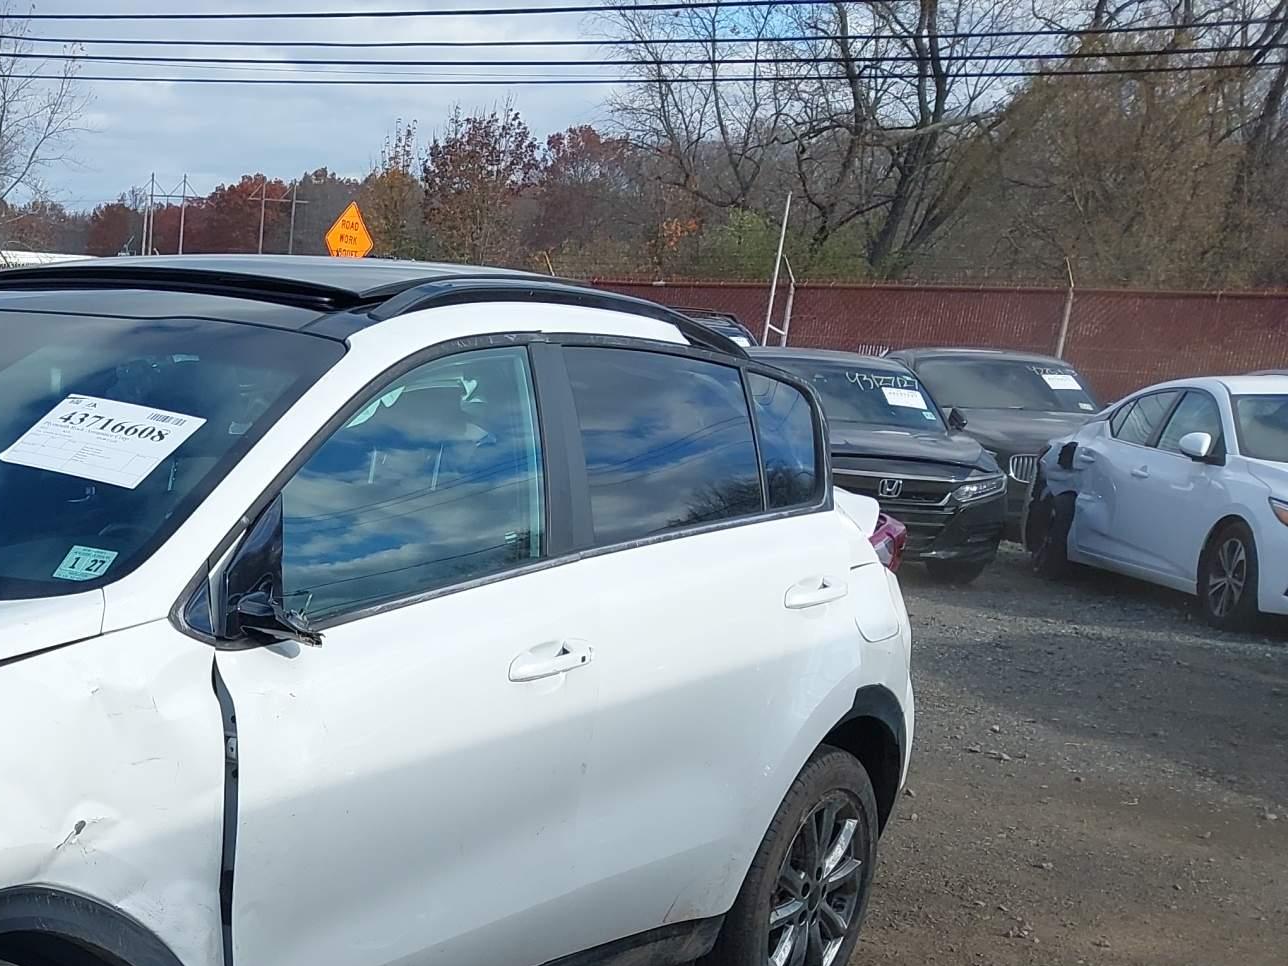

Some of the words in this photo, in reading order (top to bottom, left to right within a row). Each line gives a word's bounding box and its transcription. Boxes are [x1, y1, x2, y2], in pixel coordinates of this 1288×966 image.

[342, 219, 360, 231] ROAD
[339, 234, 357, 246] WORK
[58, 411, 172, 442] 43716608
[68, 556, 81, 570] 1
[84, 559, 106, 573] 27
